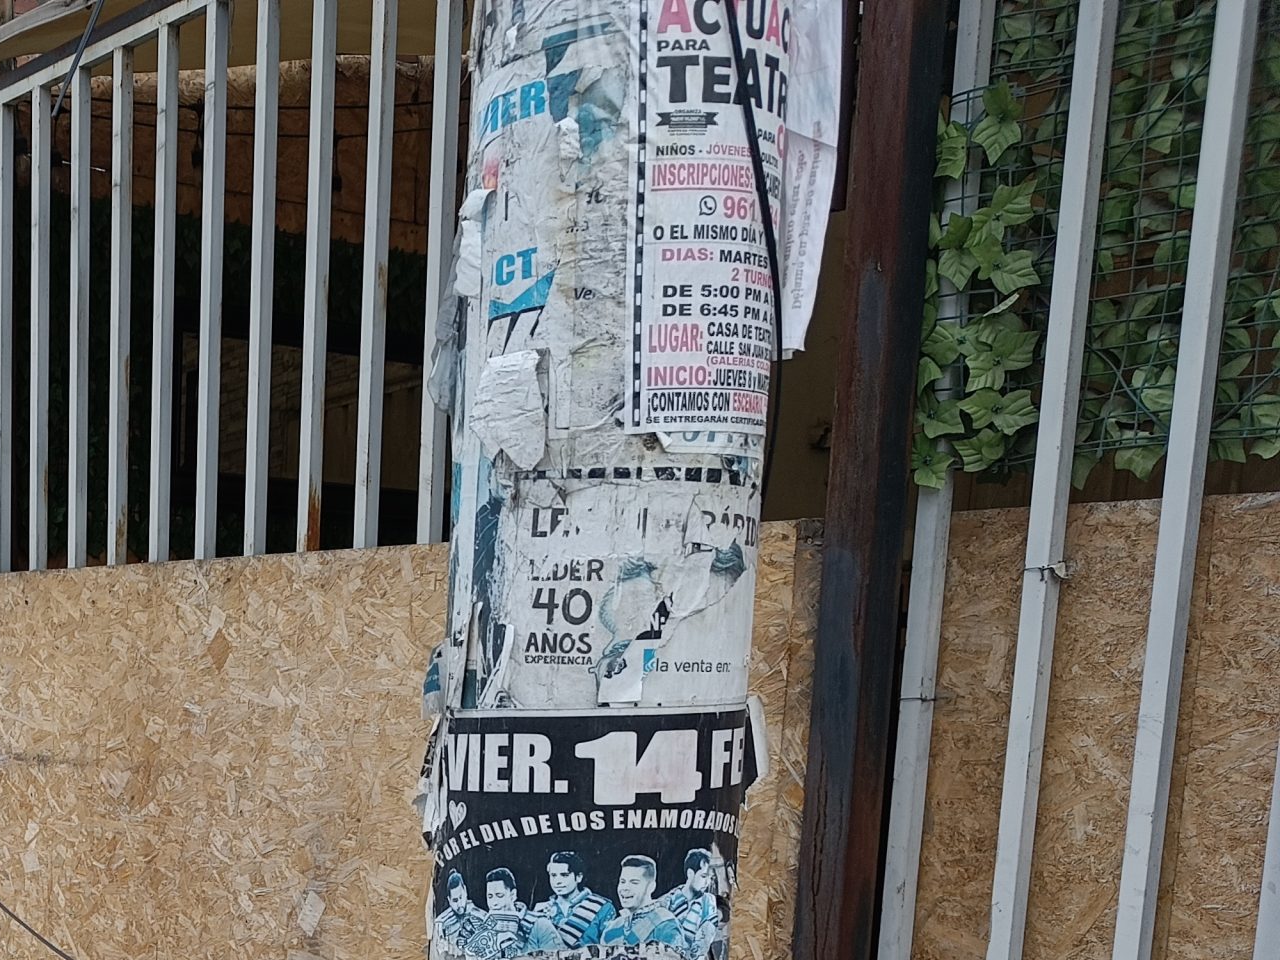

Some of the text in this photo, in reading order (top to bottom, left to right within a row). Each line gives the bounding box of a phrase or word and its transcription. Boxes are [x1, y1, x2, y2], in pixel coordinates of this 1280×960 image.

[657, 39, 711, 52] PARA
[656, 143, 695, 157] NIÑOS
[706, 142, 753, 158] JÓVENES
[651, 163, 753, 189] INSCRIPCIONES:
[653, 225, 665, 241] O
[670, 225, 689, 240] EL
[693, 224, 738, 242] MISMO
[661, 248, 768, 269] DIAS: MARTES
[731, 267, 740, 282] 2
[662, 285, 693, 298] DE
[700, 284, 740, 299] 5:00
[745, 287, 761, 303] PM
[662, 303, 693, 316] DE
[699, 303, 739, 318] 6:45
[744, 305, 760, 321] PM
[648, 323, 703, 353] LUGAR:
[707, 322, 739, 338] CASA
[741, 327, 753, 339] DE
[706, 341, 734, 356] CALLE
[738, 342, 751, 357] SAN
[647, 365, 712, 387] INICIO:
[712, 368, 747, 388] JUEVES
[647, 391, 710, 417] ¡CONTAMOS
[711, 391, 730, 412] CON
[645, 416, 661, 424] SE
[663, 414, 729, 424] ENTREGARÁN
[532, 587, 593, 626] 40
[524, 628, 593, 654] AÑOS
[524, 655, 593, 665] EXPERIENCIA
[674, 658, 713, 673] venta
[715, 662, 731, 673] en:
[447, 733, 569, 793] VIER.
[574, 728, 703, 806] 14
[434, 836, 460, 868] POR
[459, 828, 480, 850] EL
[479, 819, 519, 844] DIA
[520, 814, 553, 836] DE
[557, 810, 606, 832] LOS
[613, 809, 734, 834] ENAMORADOS
